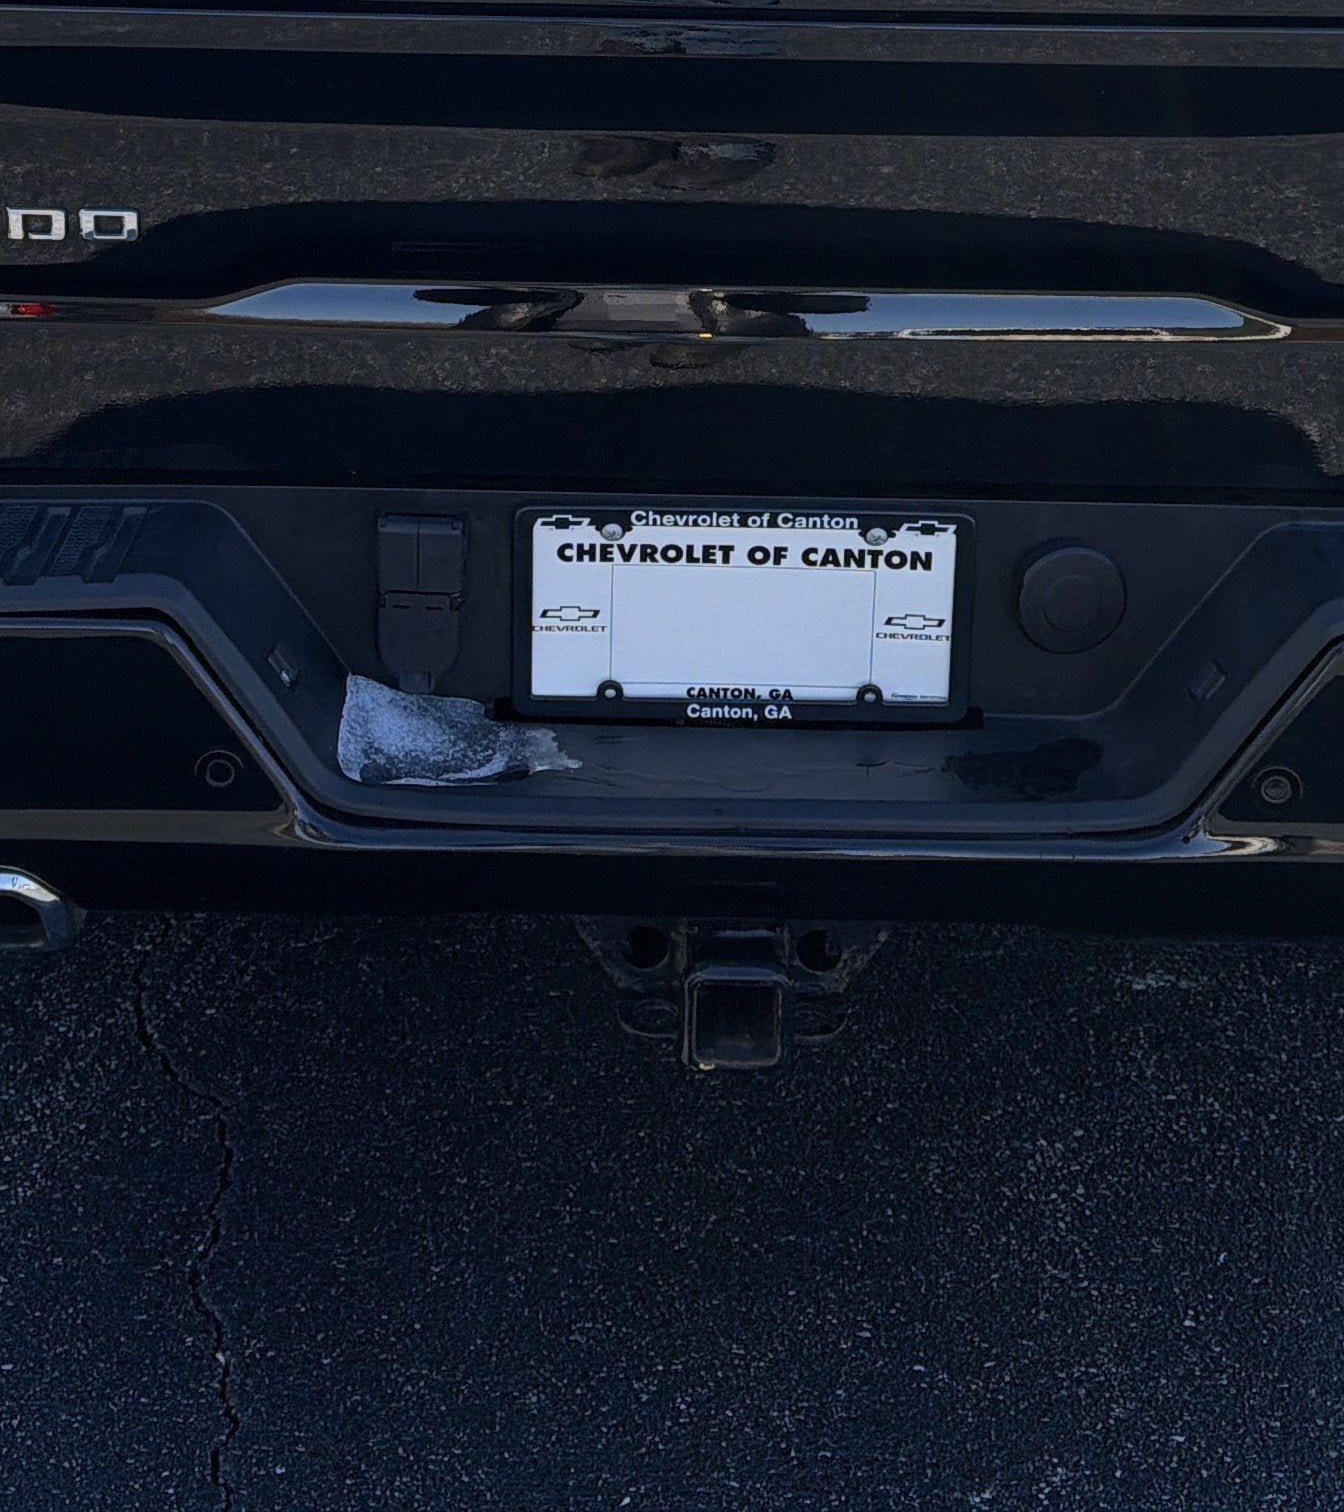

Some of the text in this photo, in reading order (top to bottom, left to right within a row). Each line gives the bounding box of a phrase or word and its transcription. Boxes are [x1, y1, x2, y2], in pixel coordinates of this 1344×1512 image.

[630, 510, 859, 530] Chevrolet of Canton
[556, 542, 933, 571] CHEVROLET OF CANTON
[532, 625, 608, 633] CHEVROLET
[875, 632, 951, 642] CHEVROLET
[686, 687, 794, 701] CANTON, GA
[686, 703, 792, 722] Canton, GA
